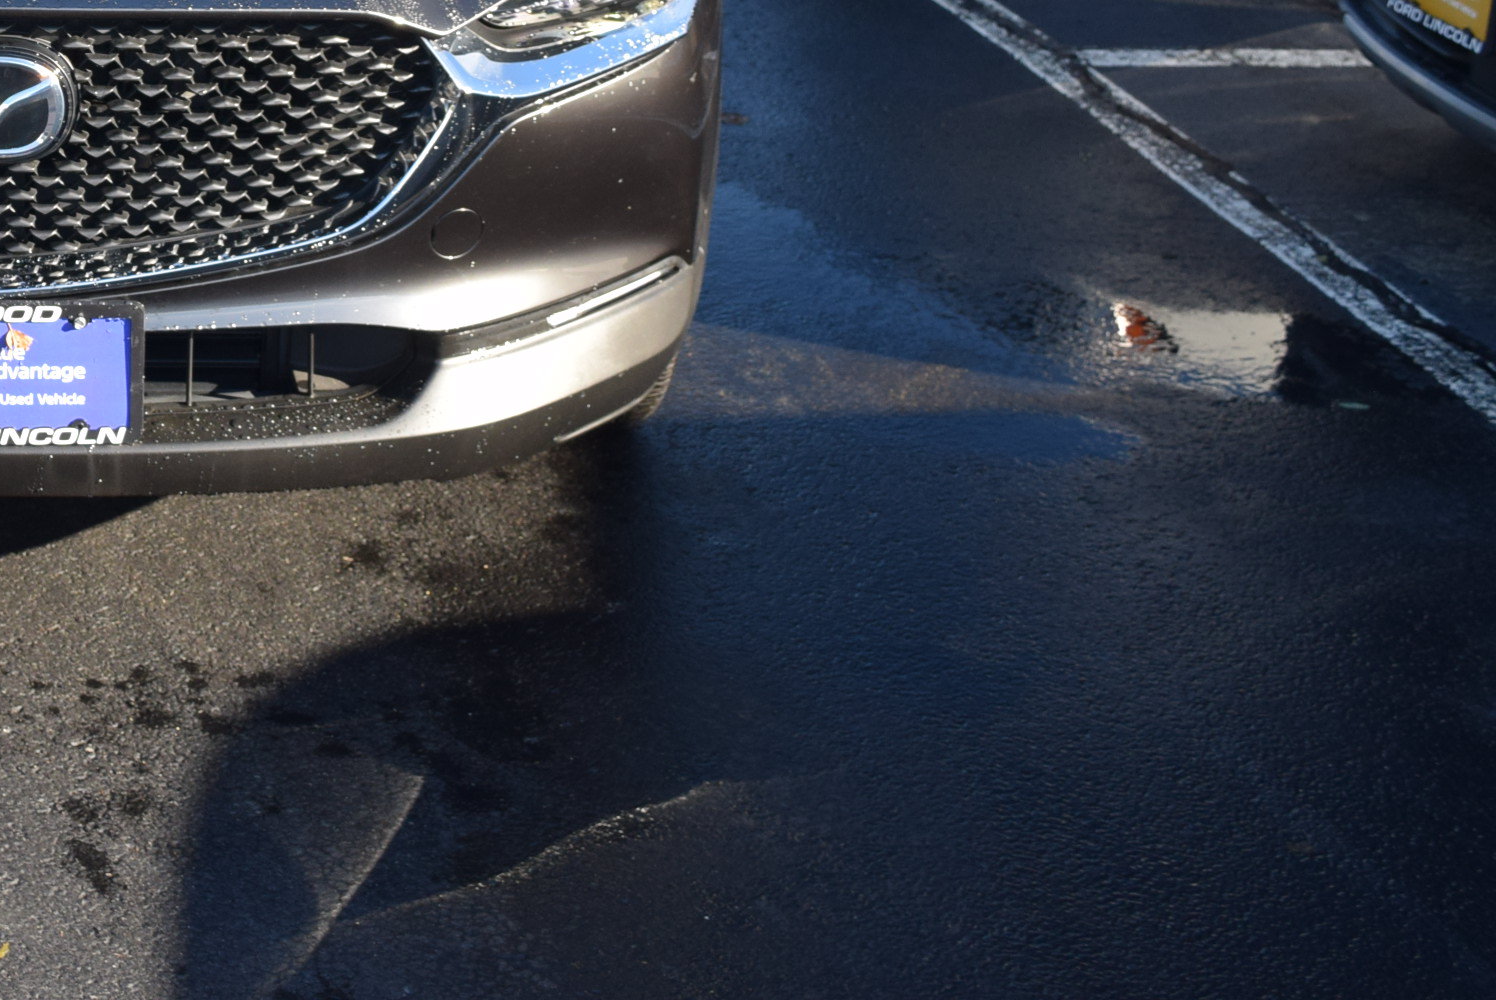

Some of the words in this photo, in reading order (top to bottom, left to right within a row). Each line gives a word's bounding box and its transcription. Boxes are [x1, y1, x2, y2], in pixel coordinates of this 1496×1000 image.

[1422, 14, 1484, 54] LINCOLN
[0, 392, 34, 405] Used
[36, 392, 86, 405] Vehicle
